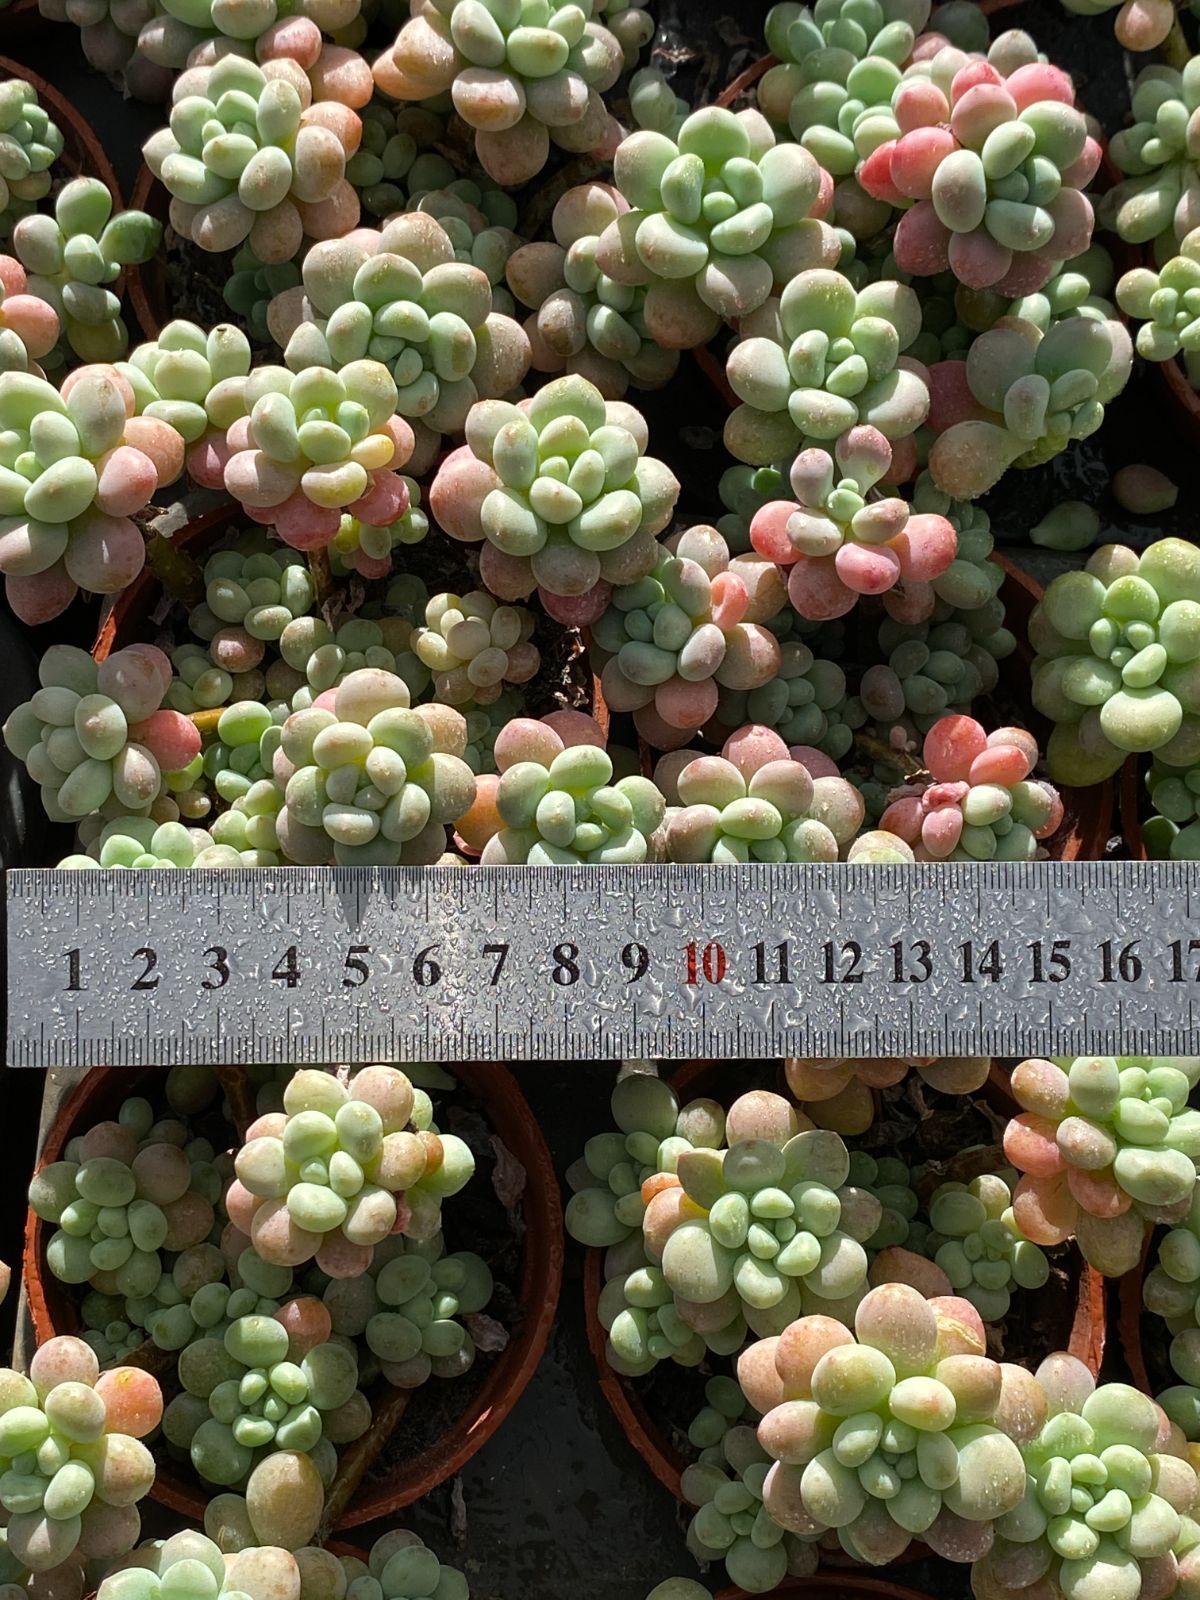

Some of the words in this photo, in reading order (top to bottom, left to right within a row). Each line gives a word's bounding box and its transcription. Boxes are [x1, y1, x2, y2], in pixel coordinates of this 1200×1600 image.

[62, 948, 89, 990] 1
[130, 947, 160, 990] 2
[201, 946, 230, 989] 3
[271, 945, 301, 987] 4
[342, 945, 371, 988] 5
[412, 944, 443, 987] 6
[481, 944, 510, 986] 7
[551, 943, 580, 986] 8
[621, 942, 649, 984] 9
[682, 942, 726, 984] 10
[751, 941, 794, 983] 11
[820, 941, 863, 983] 12
[889, 941, 934, 983] 13
[957, 940, 1003, 982] 14
[1027, 940, 1072, 982] 15
[1096, 940, 1143, 982] 16
